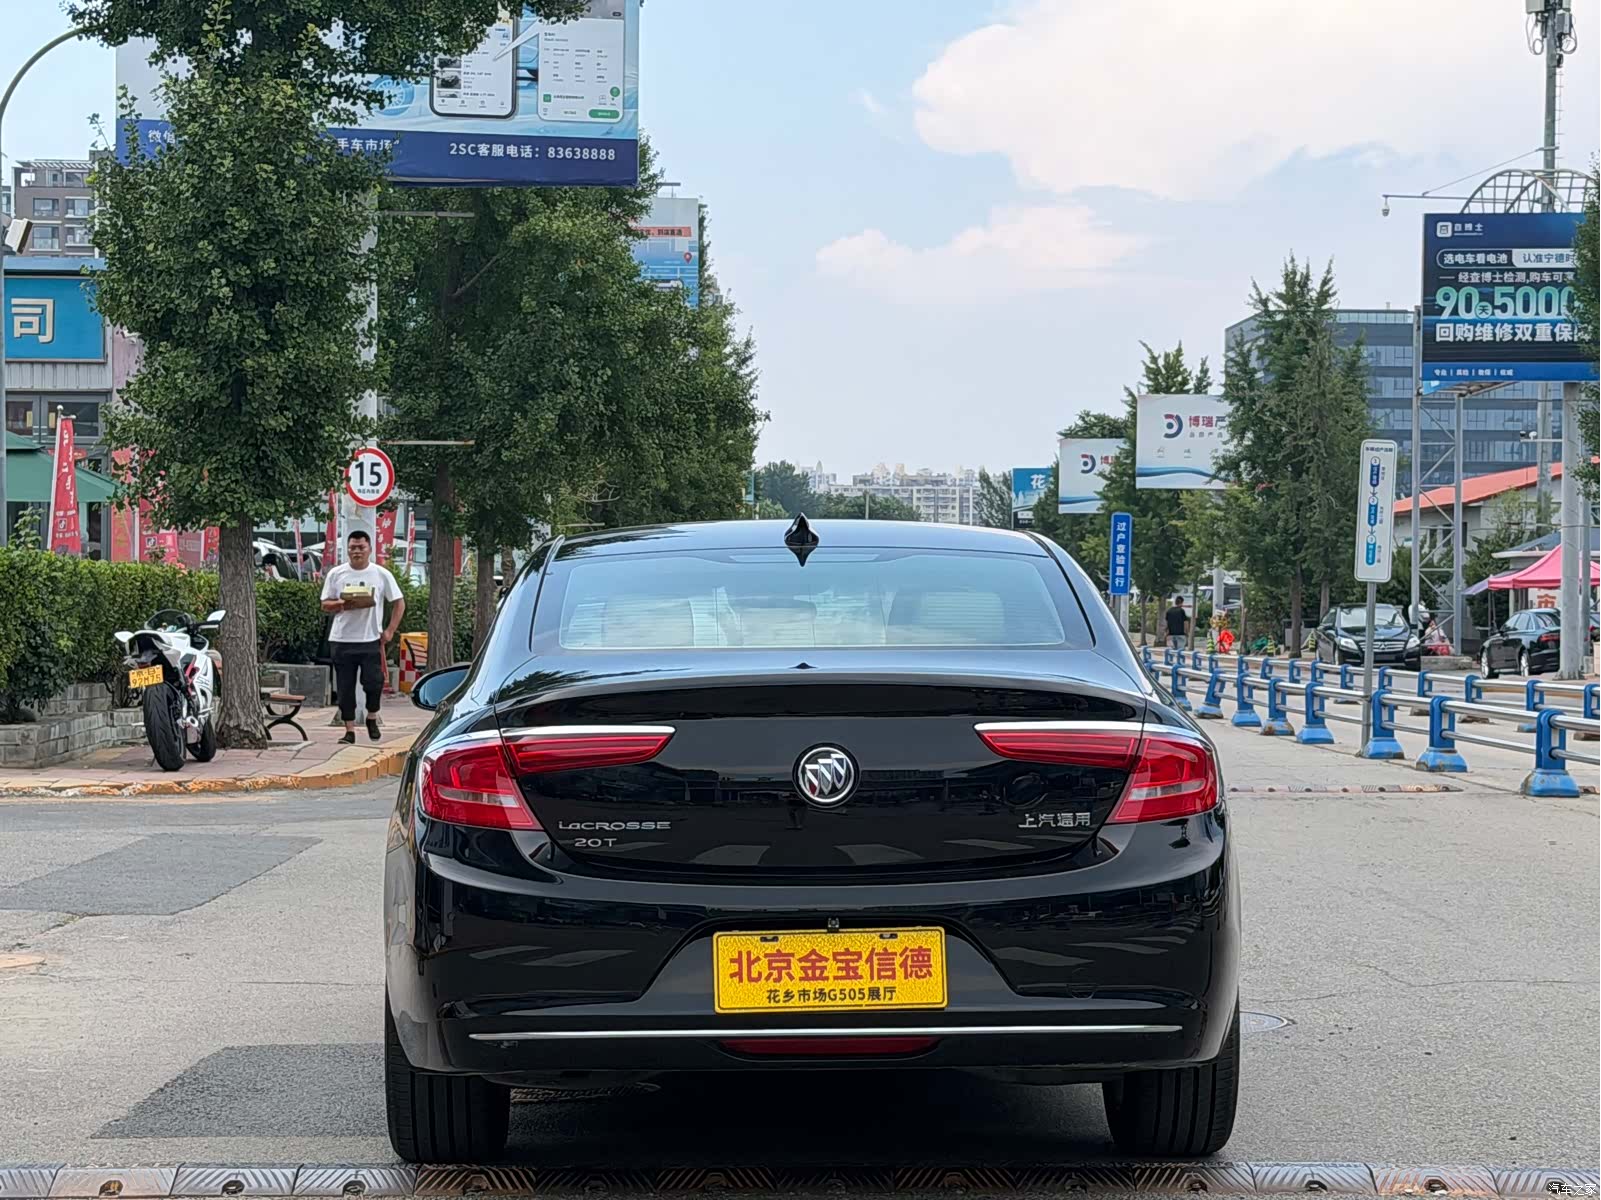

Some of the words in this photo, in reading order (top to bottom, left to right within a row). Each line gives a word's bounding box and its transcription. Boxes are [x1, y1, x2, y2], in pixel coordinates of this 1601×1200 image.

[1443, 253, 1508, 265] 选电车看电池
[11, 298, 54, 343] 司
[355, 461, 382, 487] 15
[1030, 474, 1046, 489] 花
[1114, 521, 1127, 588] 过户查验直行
[1018, 812, 1091, 828] 上汽通用
[574, 837, 617, 848] 20T
[729, 945, 933, 984] 北京金宝信德
[767, 986, 897, 1004] 花乡市场G505展厅
